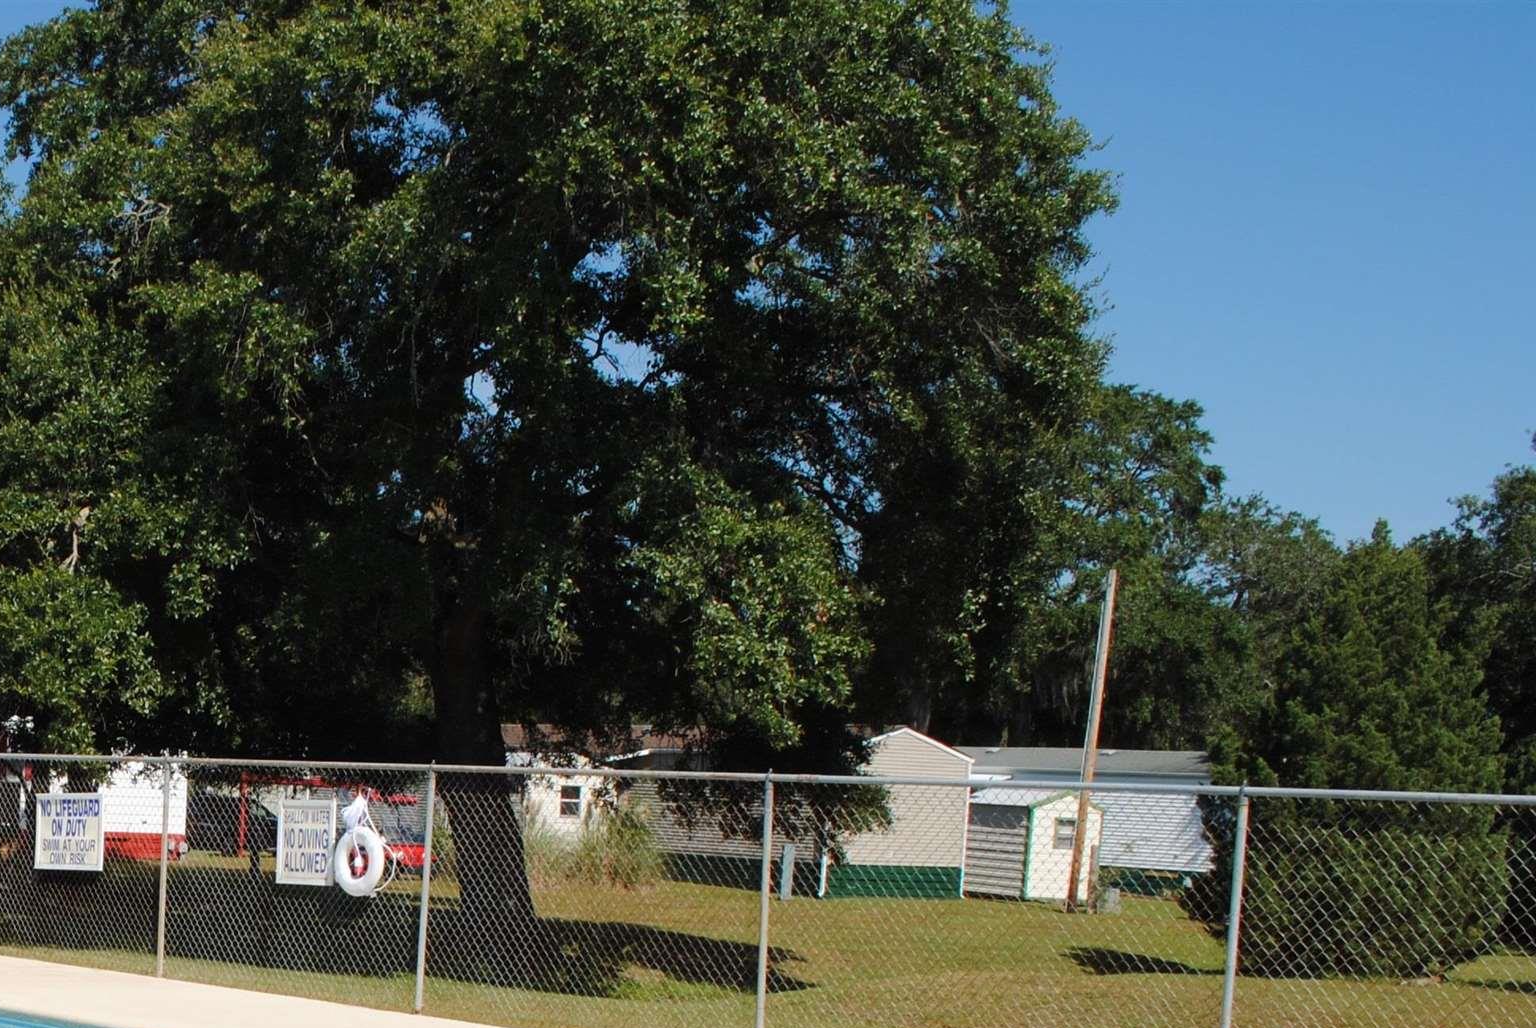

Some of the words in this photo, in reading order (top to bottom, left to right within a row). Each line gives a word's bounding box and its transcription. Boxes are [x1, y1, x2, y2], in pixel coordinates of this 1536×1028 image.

[41, 799, 52, 816] NO
[56, 799, 100, 817] LIFEGUARD
[52, 819, 63, 836] ON
[66, 819, 86, 837] DUTY
[43, 839, 60, 851] SWIM
[63, 839, 72, 851] AT
[76, 840, 96, 852] YOUR
[284, 828, 295, 848] NO
[298, 828, 329, 849] DIVING
[50, 852, 66, 864] OWN
[70, 852, 87, 865] RISK
[284, 852, 327, 874] ALLOWED
